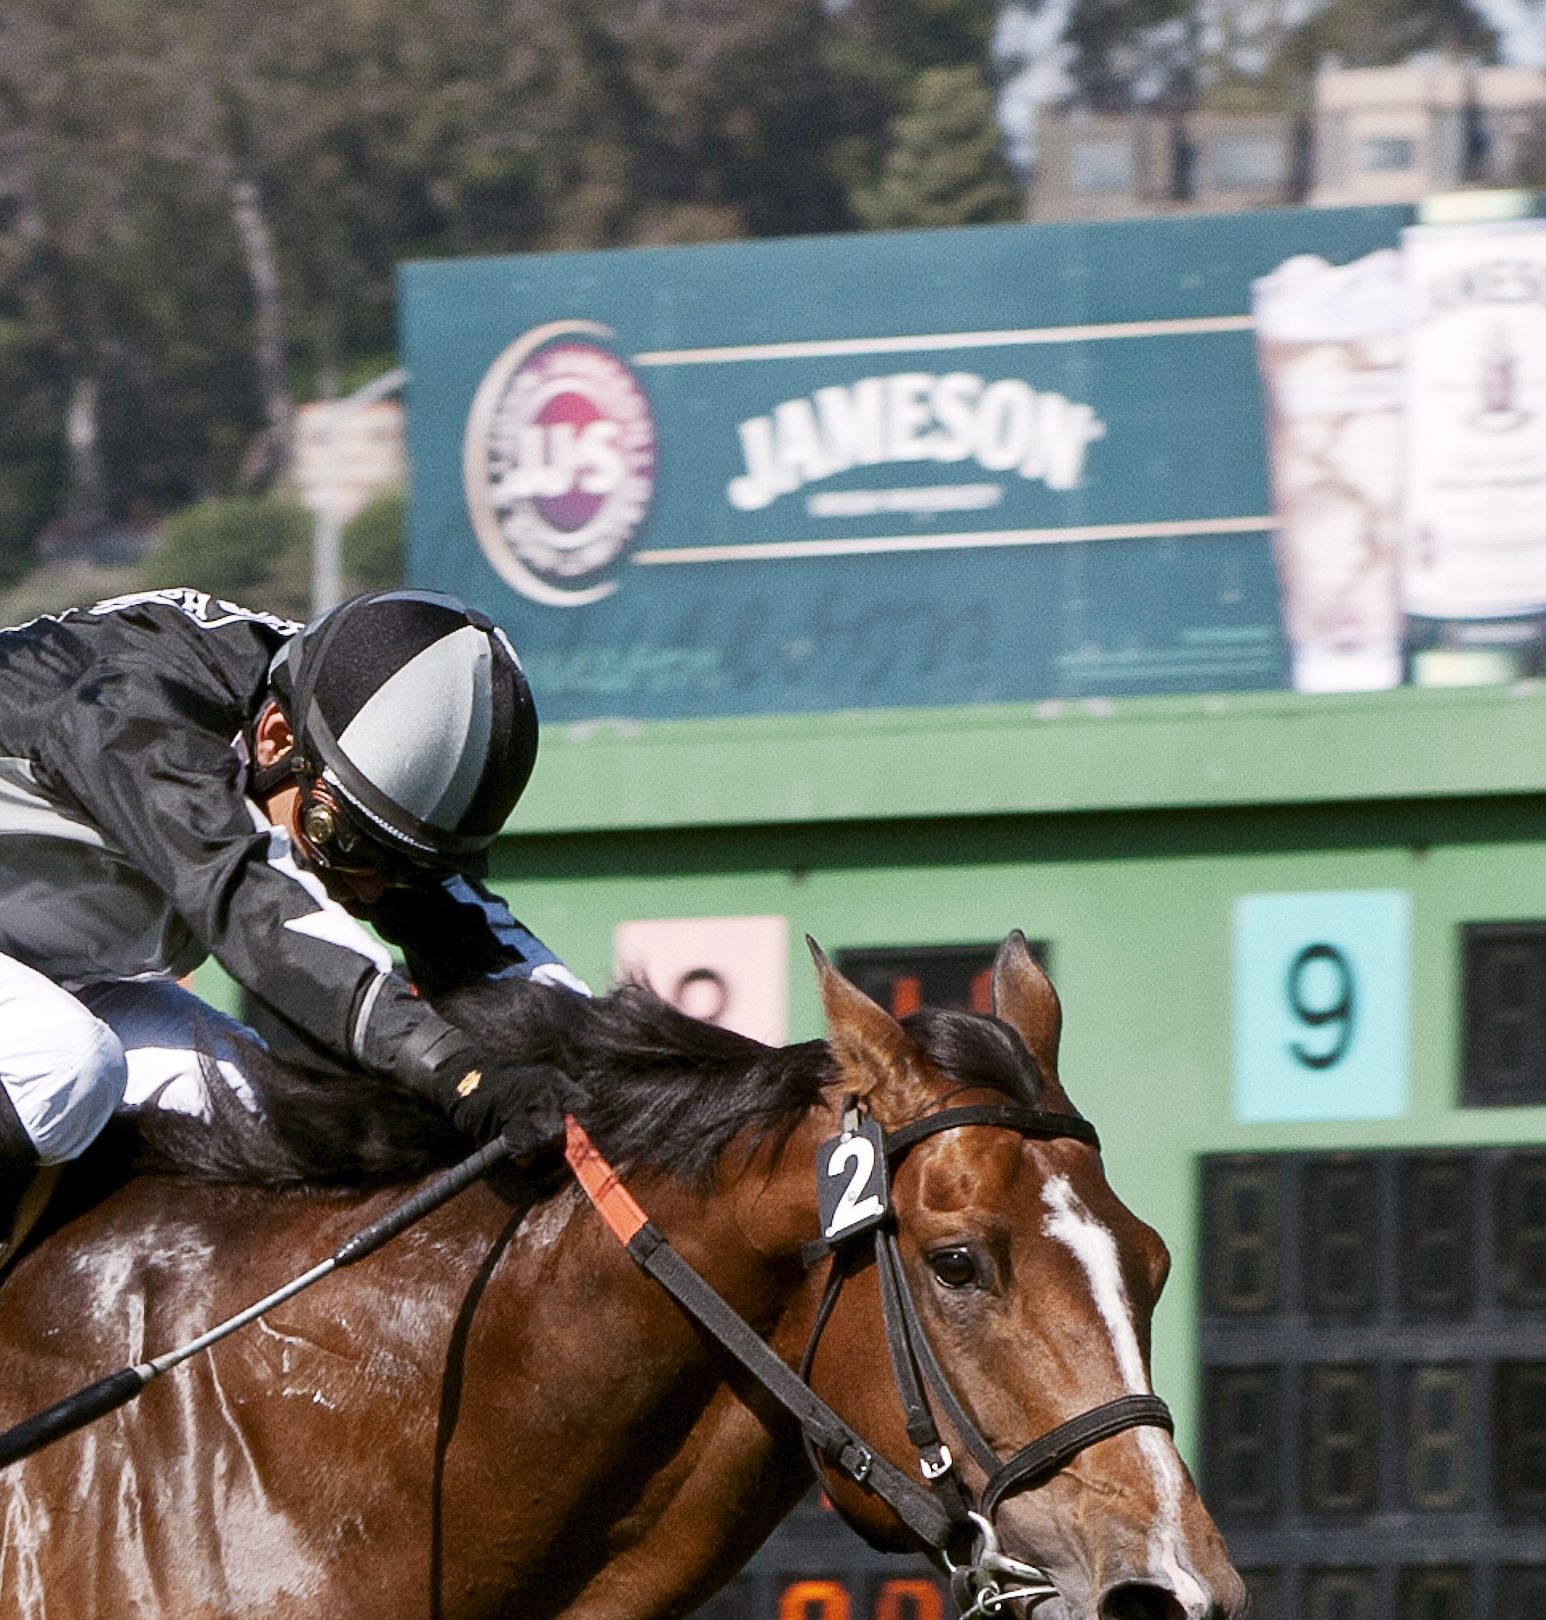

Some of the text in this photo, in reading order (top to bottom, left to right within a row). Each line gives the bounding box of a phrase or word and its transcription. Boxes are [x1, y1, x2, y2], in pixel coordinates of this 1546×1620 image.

[727, 371, 1108, 511] JAMESON
[1285, 943, 1355, 1069] 9
[825, 1136, 887, 1238] 2
